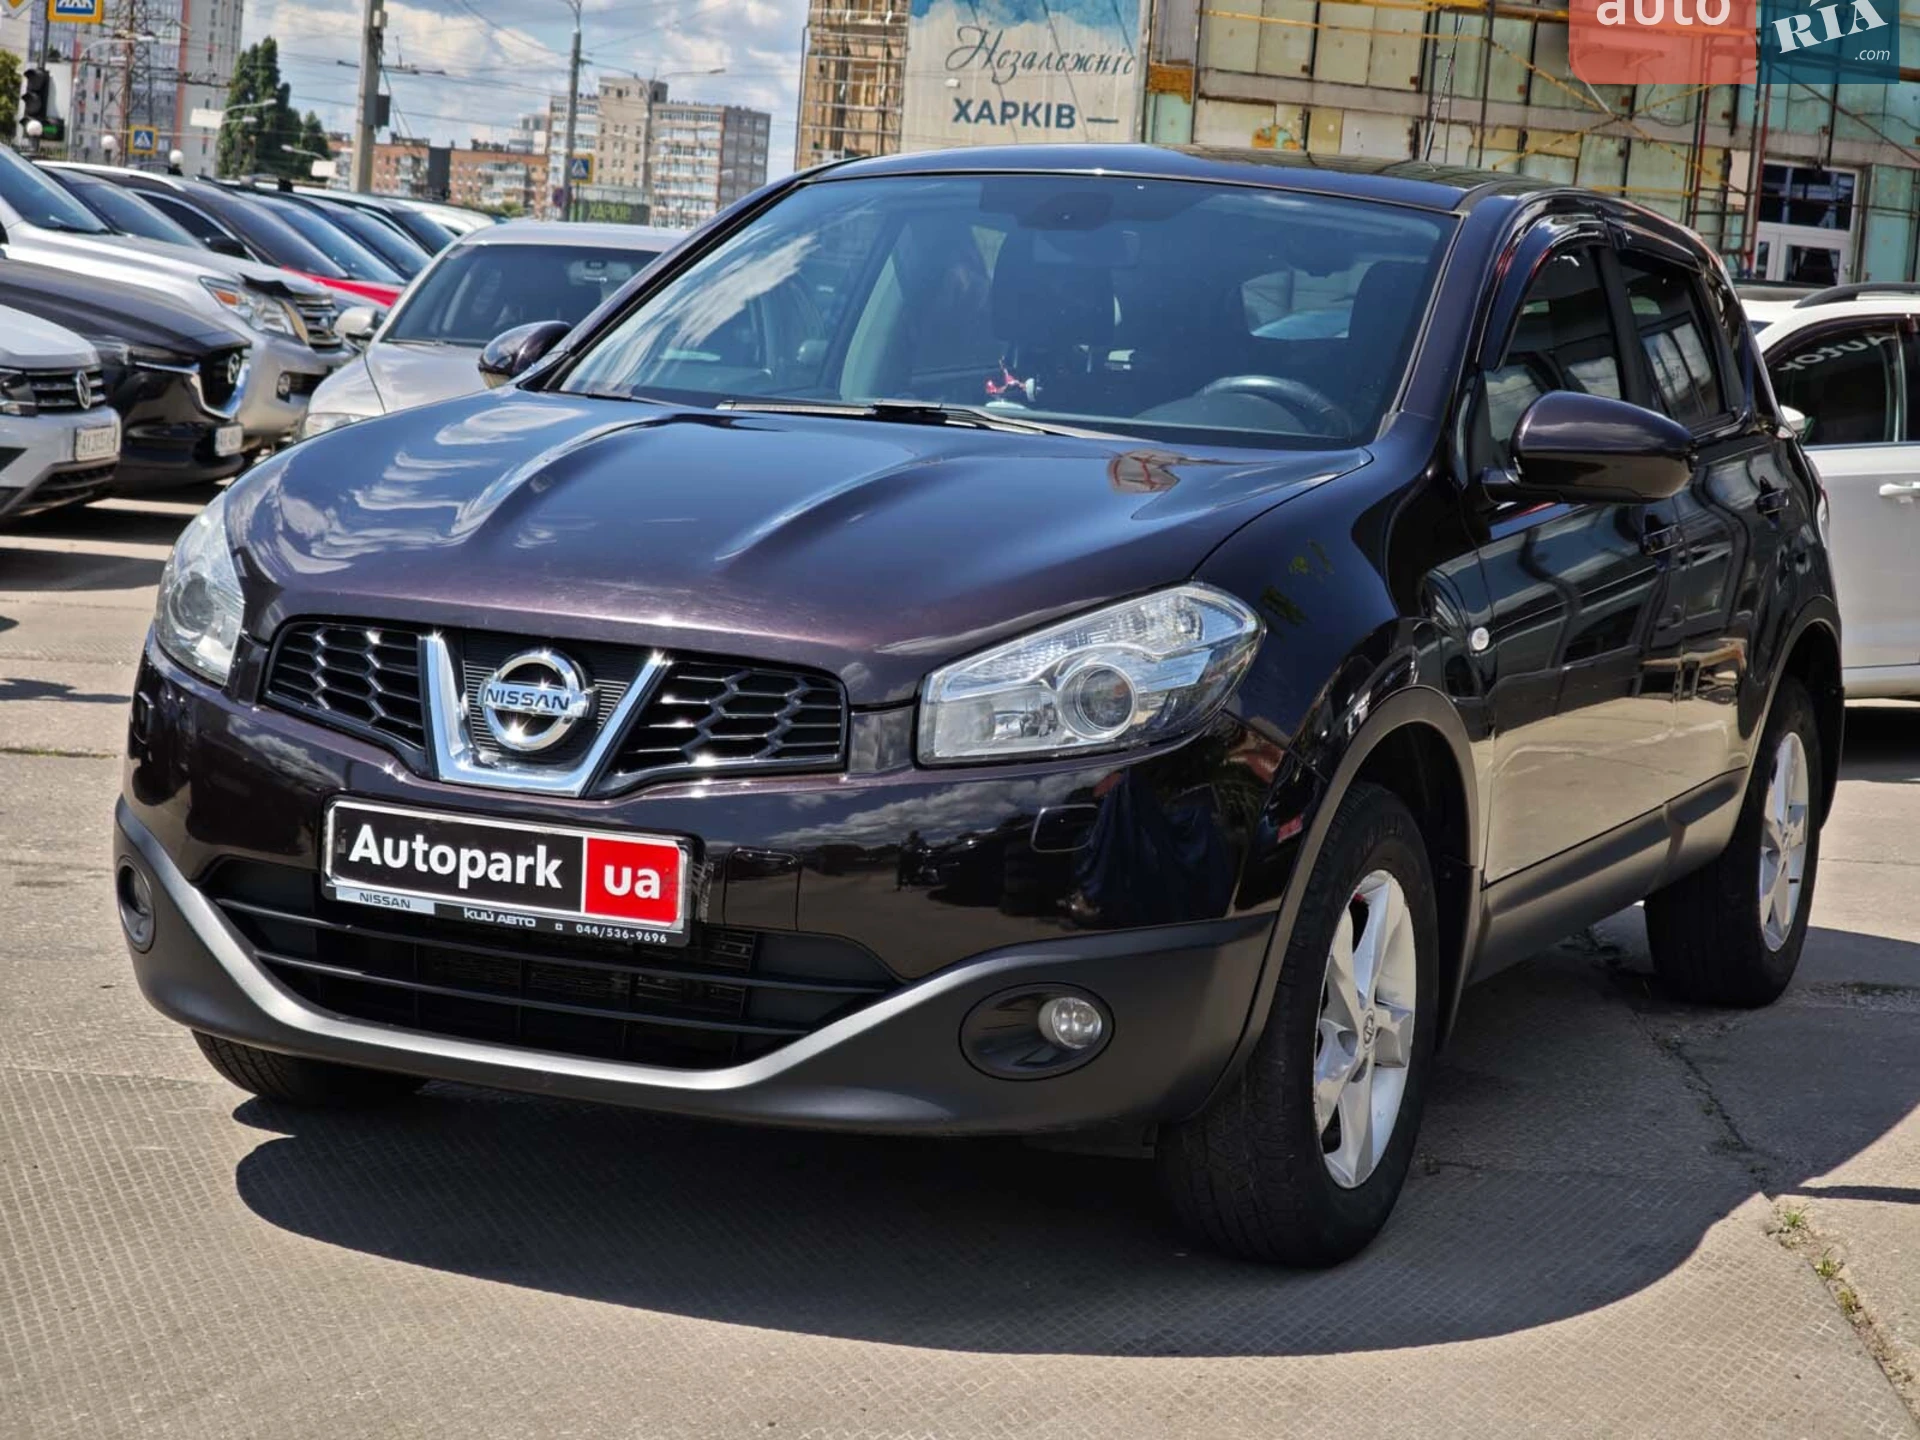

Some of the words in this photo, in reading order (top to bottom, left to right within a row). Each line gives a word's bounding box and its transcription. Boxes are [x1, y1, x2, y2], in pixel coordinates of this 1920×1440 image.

[952, 98, 1076, 129] ХАРКІВ
[485, 689, 570, 711] NISSAN
[348, 824, 564, 889] Autopark
[603, 863, 660, 900] ua
[359, 892, 411, 909] NISSAN
[576, 923, 667, 944] 044/536-9696
